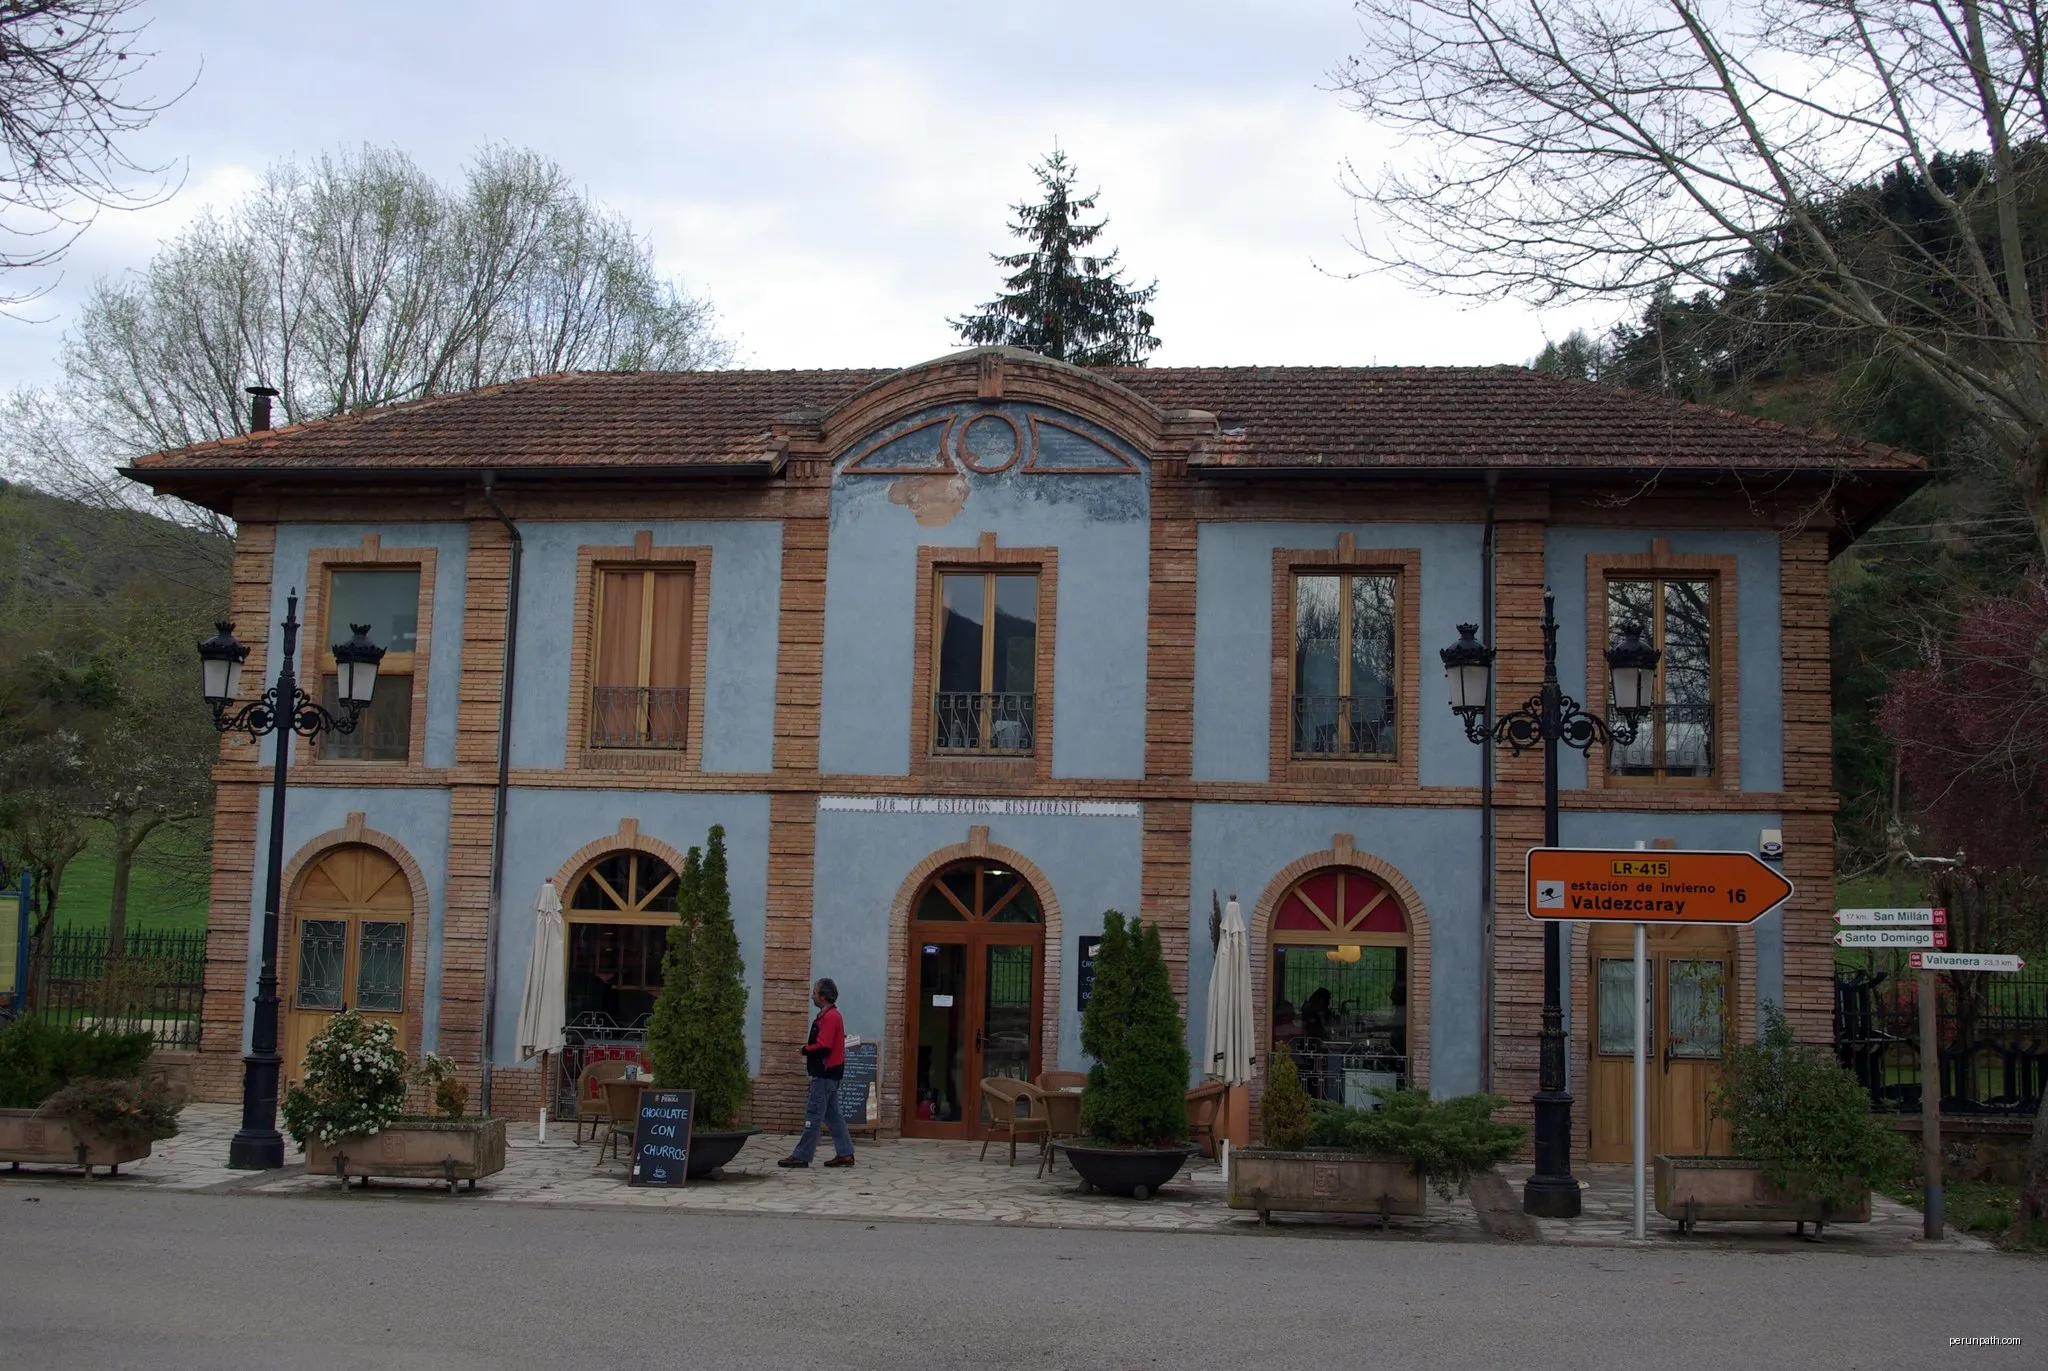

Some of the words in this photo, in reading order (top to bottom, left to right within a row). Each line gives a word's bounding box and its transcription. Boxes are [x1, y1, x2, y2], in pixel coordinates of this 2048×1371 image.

[875, 799, 896, 810] BAR
[910, 799, 922, 811] LA
[1005, 802, 1081, 813] RESTAURANTE
[1613, 862, 1667, 875] LR-415
[1570, 880, 1628, 893] estación
[1636, 882, 1653, 893] de
[1661, 882, 1716, 894] invierno
[1727, 888, 1747, 904] 16
[1571, 895, 1685, 915] Valdezcaray
[1874, 911, 1895, 921] San
[1897, 910, 1930, 921] Millán
[1845, 932, 1877, 943] Santo
[1881, 932, 1930, 944] Domingo
[1926, 955, 1980, 966] Valvanera
[641, 1107, 688, 1120] CHOCOLATE
[650, 1124, 676, 1138] CON
[643, 1143, 686, 1161] CHURROS
